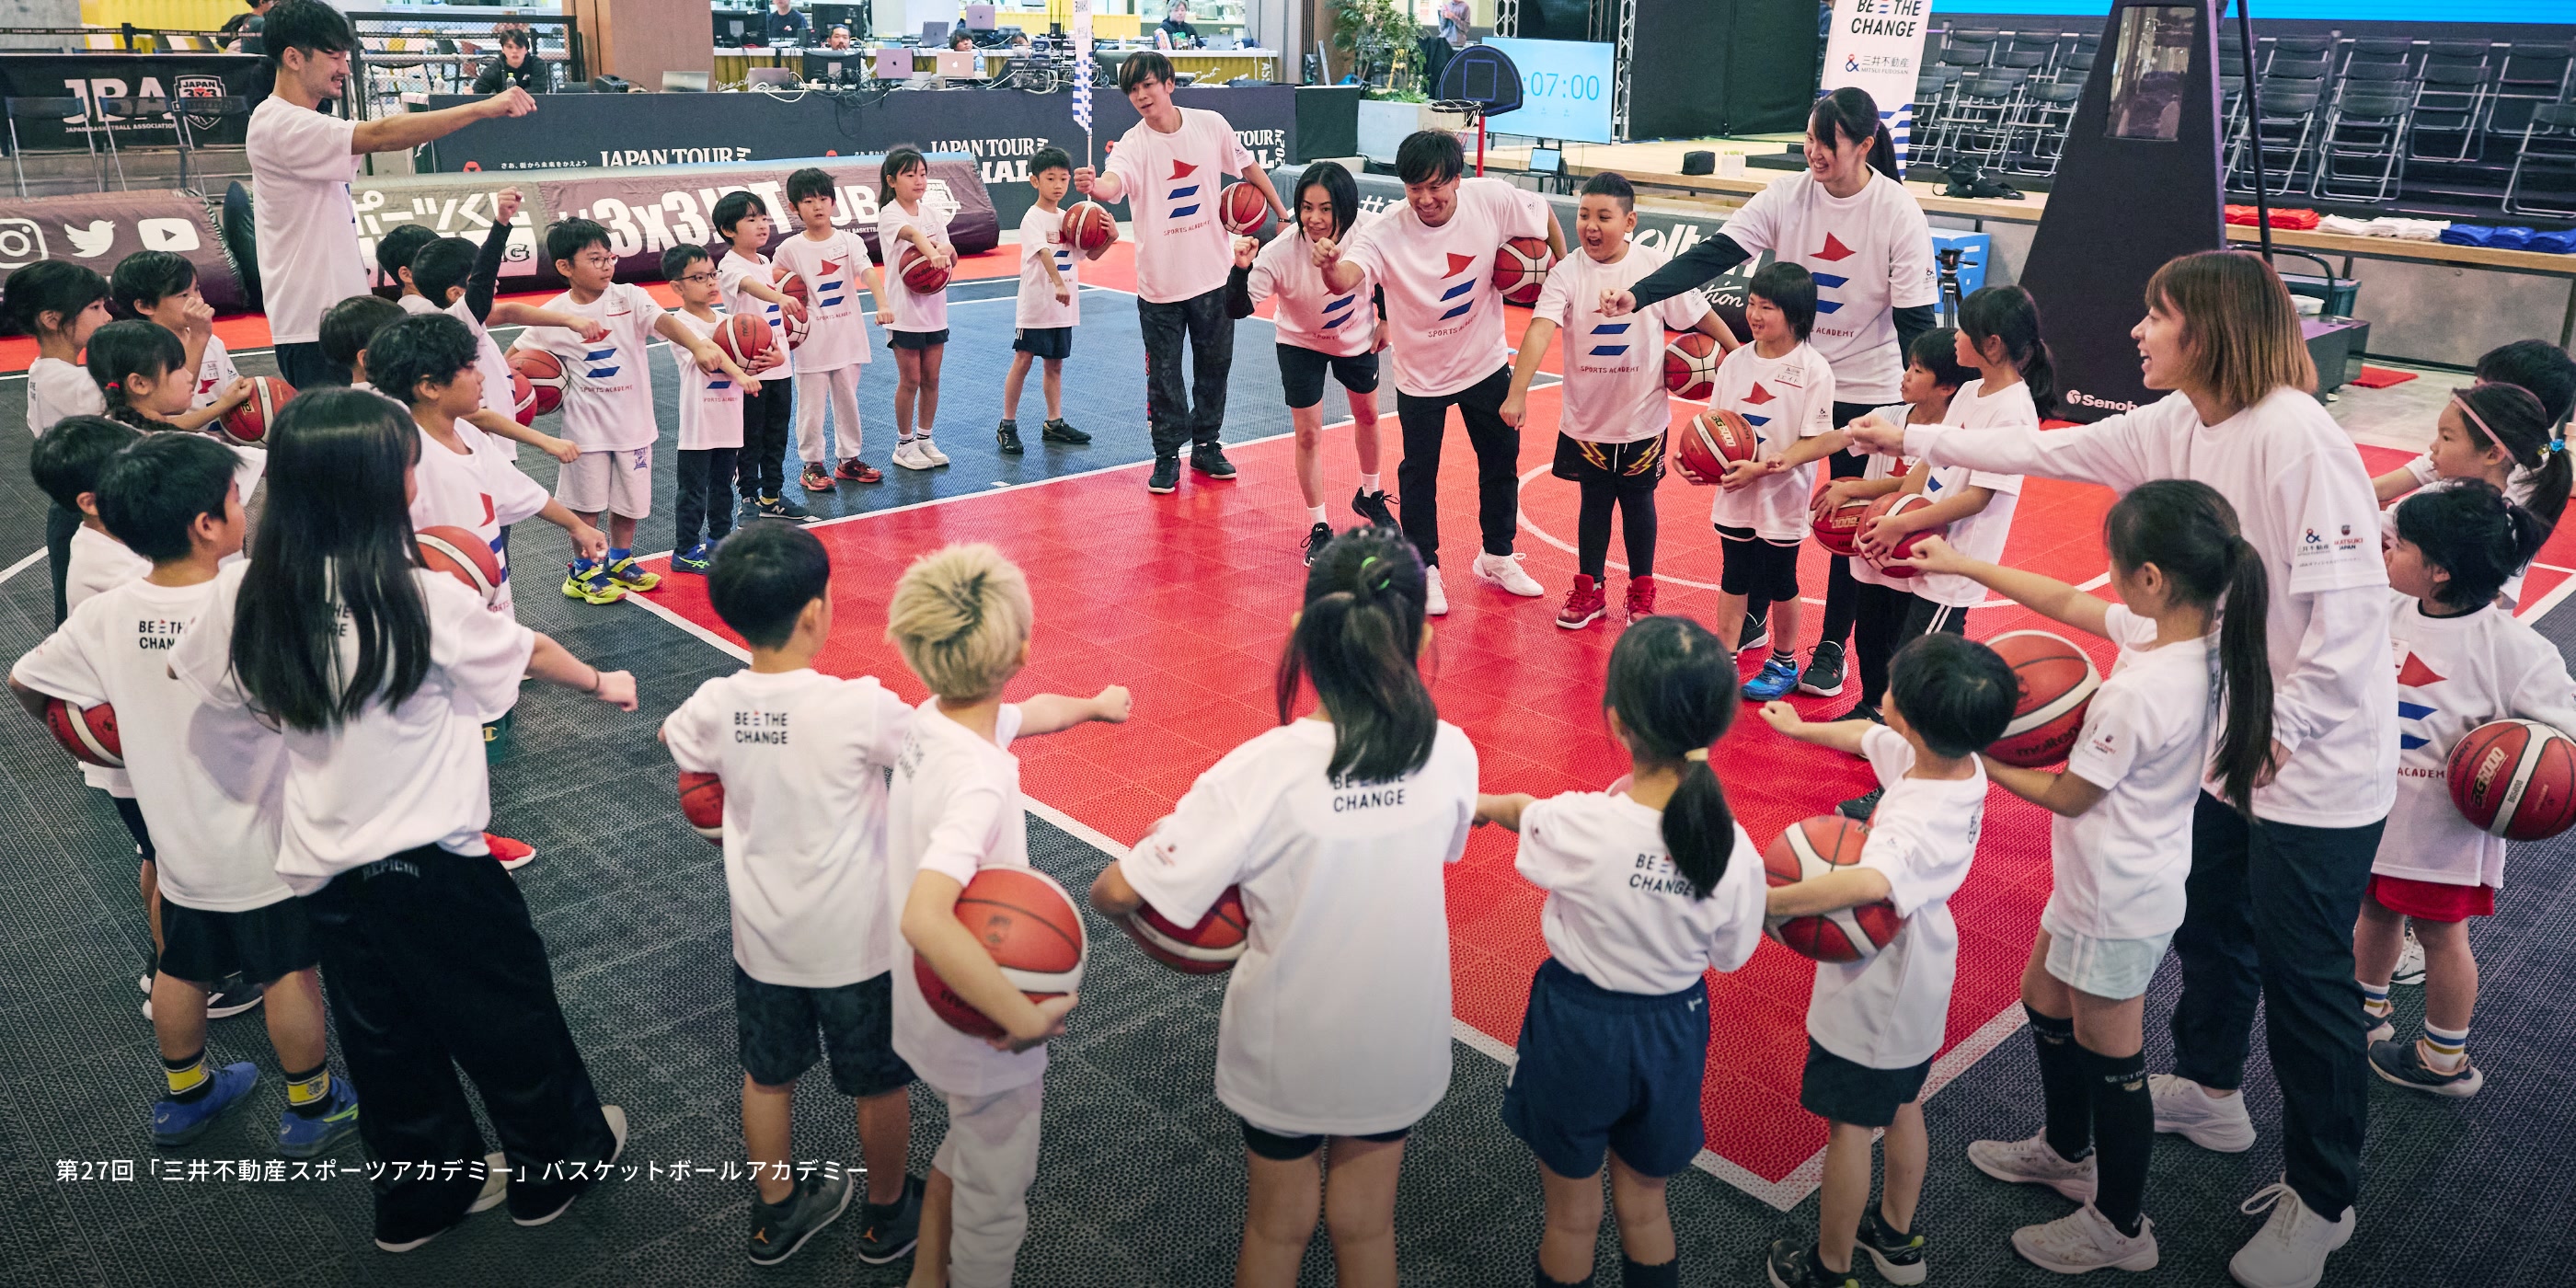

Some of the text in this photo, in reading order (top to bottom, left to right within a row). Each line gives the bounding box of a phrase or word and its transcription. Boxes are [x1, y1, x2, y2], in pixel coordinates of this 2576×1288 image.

[1857, 0, 1923, 17] BE THE
[1851, 17, 1917, 38] CHANGE
[1862, 55, 1910, 68] 三井不動産
[63, 76, 174, 124] JBA
[90, 123, 132, 132] BASKTBALL
[1234, 129, 1274, 146] TOUR
[931, 138, 1035, 157] JAPAN TOUR
[1274, 129, 1286, 166] 2024
[600, 147, 733, 167] JAPAN TOUR
[1163, 226, 1187, 236] SPORTS
[1428, 327, 1458, 338] SPORTS
[1815, 327, 1855, 338] ACADEMY
[1581, 365, 1608, 374] SPORTS
[138, 620, 155, 634] BE
[139, 637, 176, 650] CHAN
[734, 711, 788, 727] BE THE
[735, 730, 788, 745] CHANGE
[2397, 766, 2445, 779] ACADEM
[1334, 775, 1353, 790] BE
[1333, 788, 1405, 812] CHANGE
[1635, 853, 1657, 870] BE
